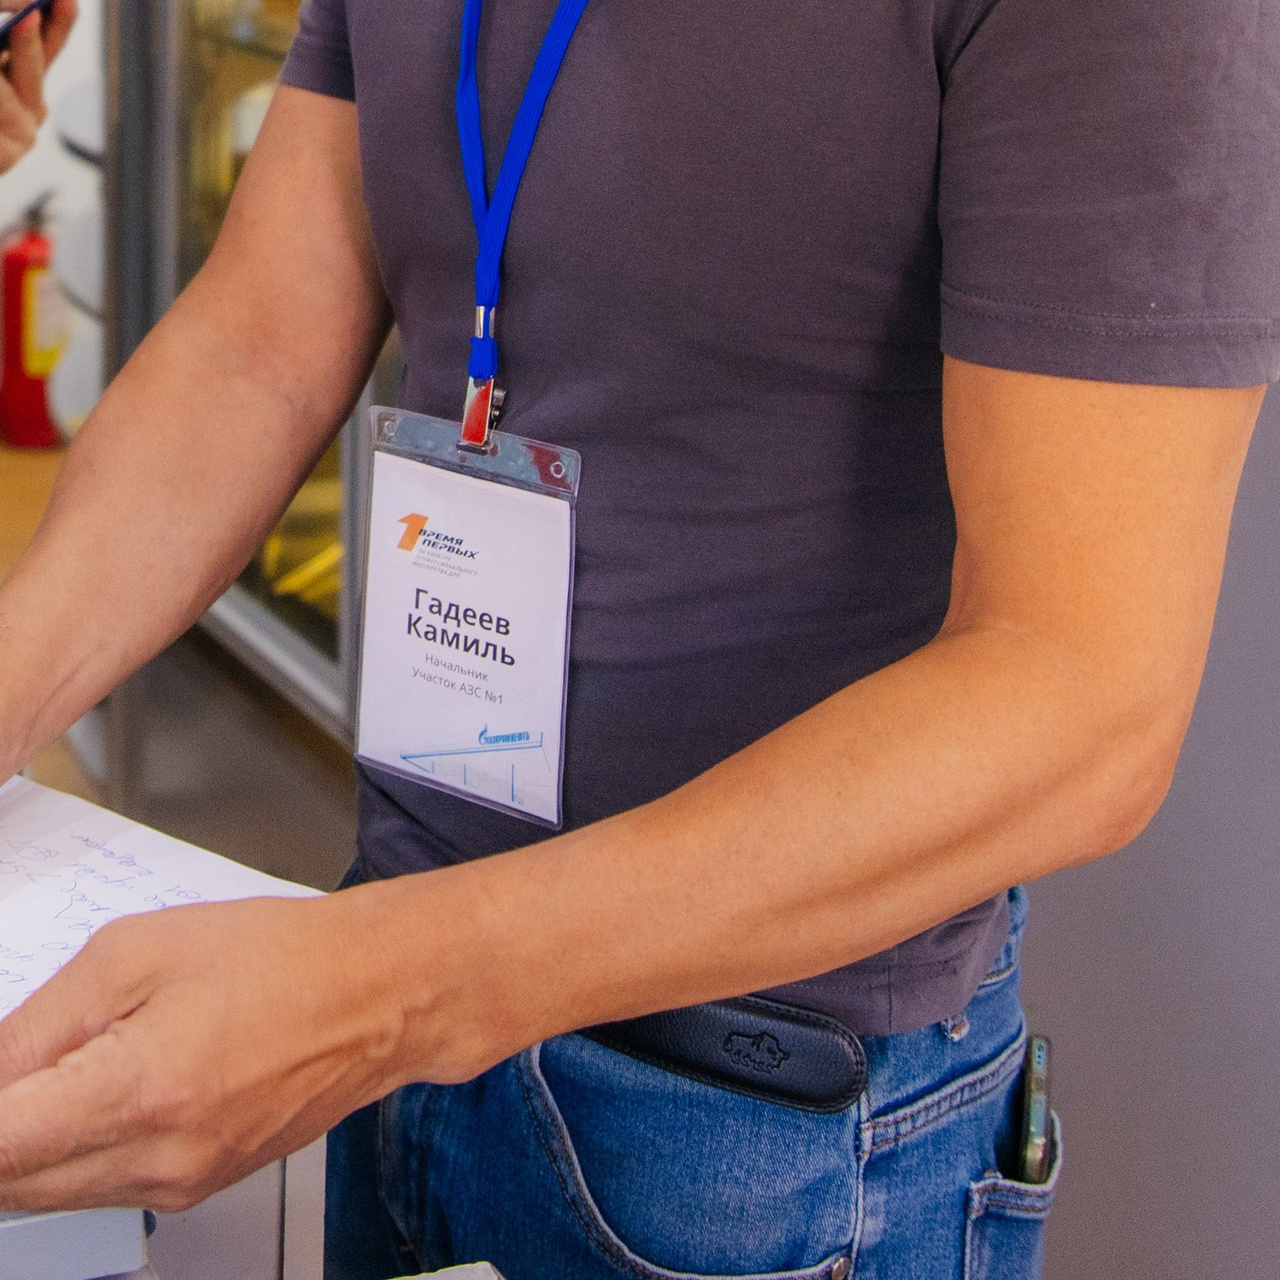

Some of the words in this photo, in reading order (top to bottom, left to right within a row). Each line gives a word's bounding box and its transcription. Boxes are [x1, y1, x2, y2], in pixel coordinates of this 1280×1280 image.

[418, 528, 464, 546] ВРЕМЯ
[422, 538, 480, 560] ПЕРВЫХ
[414, 587, 511, 637] Гадеев
[406, 613, 516, 667] Камиль
[424, 653, 489, 682] Начальник
[412, 667, 457, 690] Участок
[459, 682, 482, 699] АЗС
[484, 690, 503, 705] №1
